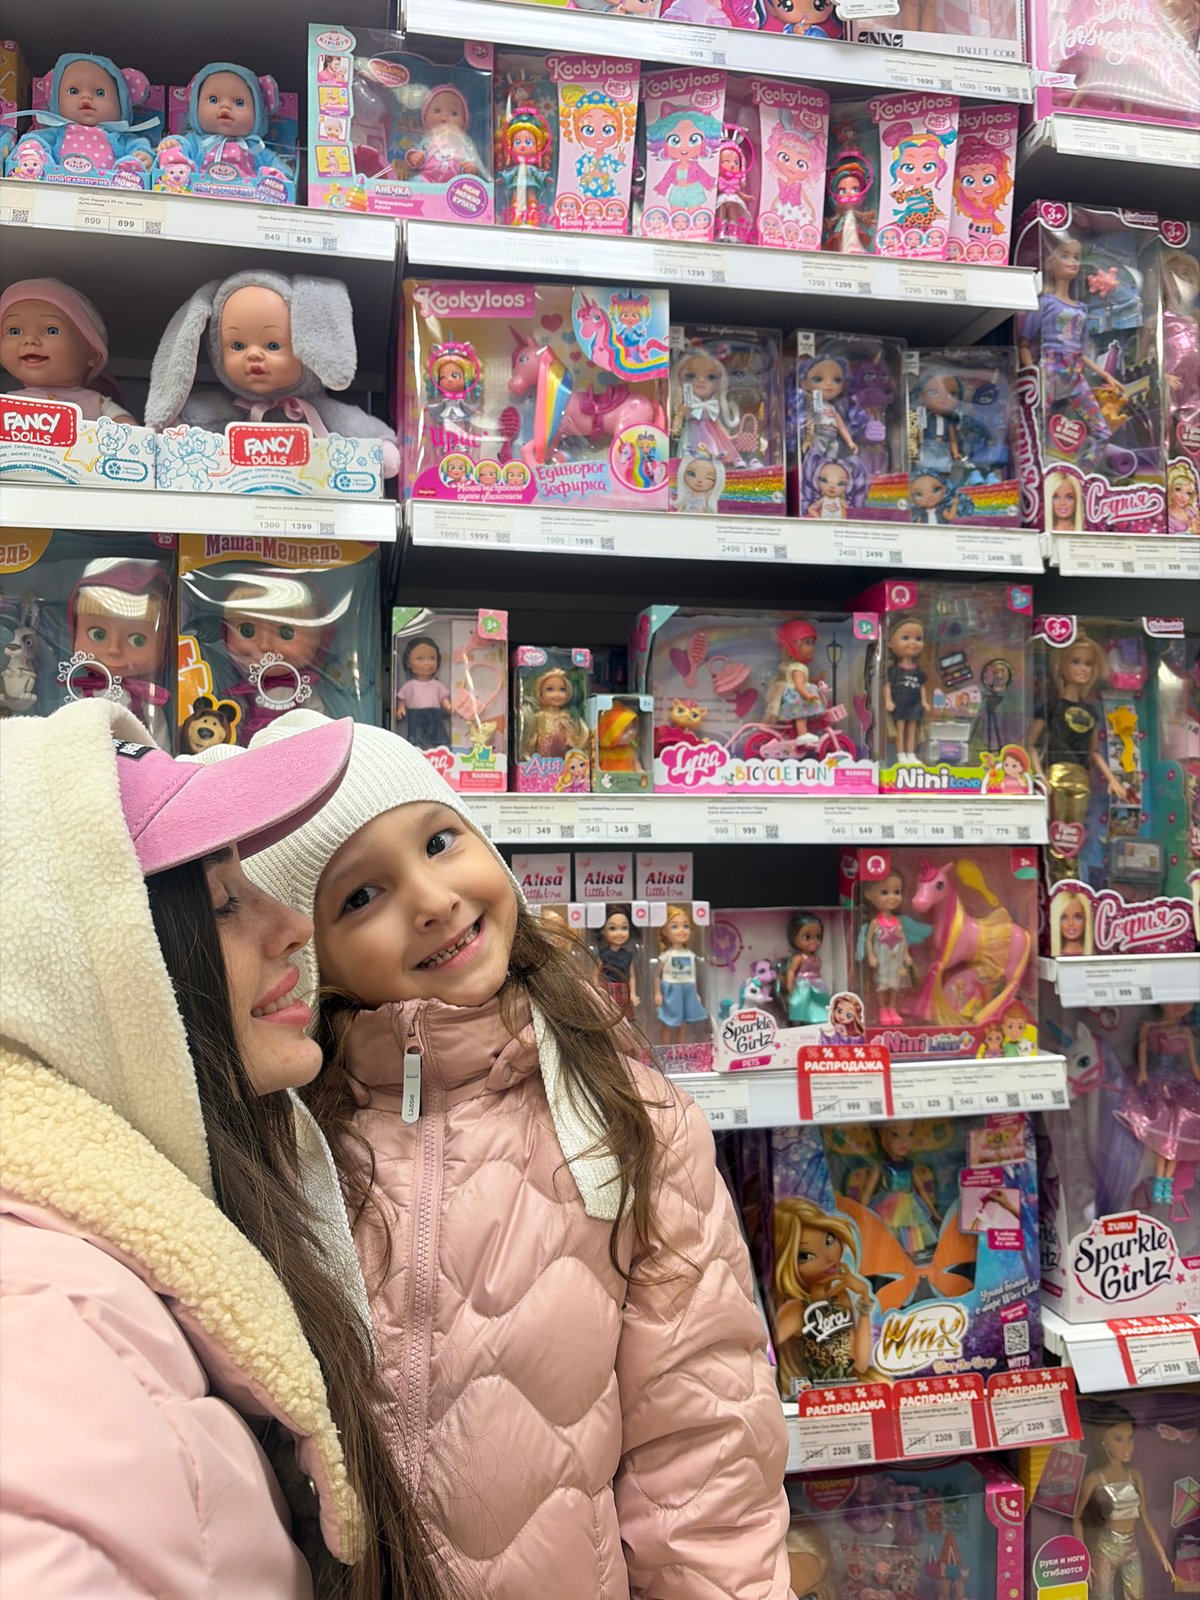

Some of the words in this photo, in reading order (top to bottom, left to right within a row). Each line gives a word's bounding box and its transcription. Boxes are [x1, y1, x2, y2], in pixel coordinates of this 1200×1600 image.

[690, 50, 704, 58] 999
[957, 46, 989, 56] BALLET
[993, 48, 1017, 59] CORE
[548, 58, 633, 80] Kookyloos
[642, 72, 720, 98] Kookyloos
[891, 75, 908, 83] 1699
[917, 77, 934, 86] 1699
[959, 82, 976, 90] 1699
[984, 85, 1001, 93] 1699
[752, 82, 823, 108] Kookyloos
[870, 97, 953, 122] Kookyloos
[958, 113, 1012, 135] okyloos
[48, 175, 65, 183] МОЙ
[66, 177, 110, 187] КАРАПУЗИК
[121, 171, 140, 184] МЕНЯ
[265, 179, 284, 191] МЕНЯ
[375, 184, 411, 197] АНЕЧКА
[462, 183, 481, 195] МЕНЯ
[259, 186, 286, 199] МОЖНО
[456, 189, 481, 205] МОЖНО
[452, 197, 478, 212] КУПАТЬ
[1047, 206, 1062, 220] 3+
[84, 217, 101, 225] 899
[118, 219, 135, 228] 899
[265, 233, 281, 241] 849
[1168, 225, 1181, 237] 3+
[296, 236, 312, 244] 849
[660, 267, 678, 275] 1299
[687, 269, 705, 277] 1299
[808, 279, 825, 287] 1299
[835, 281, 852, 289] 1299
[904, 286, 922, 294] 1299
[930, 288, 948, 296] 1299
[414, 288, 526, 314] Kookyloos
[4, 412, 60, 433] FANCY
[11, 431, 52, 445] DOLLS
[244, 435, 295, 457] FANCY
[251, 455, 287, 466] DOLLS
[536, 462, 606, 482] Единорог
[540, 478, 607, 499] Зефирка
[259, 521, 280, 529] 1399
[440, 531, 459, 539] 1999
[470, 532, 489, 540] 1999
[546, 536, 565, 544] 1999
[575, 538, 594, 546] 1999
[722, 544, 740, 552] 2499
[206, 535, 252, 557] Маша
[262, 537, 342, 562] Медведь
[486, 621, 497, 630] 3+
[1051, 622, 1067, 635] 3+
[526, 758, 560, 775] Аня
[671, 750, 721, 783] Lyna
[735, 765, 791, 782] BICYCLE
[796, 766, 827, 782] FUN
[896, 767, 949, 789] Nini
[507, 827, 522, 835] 349
[614, 825, 629, 833] 349
[714, 826, 729, 834] 999
[742, 826, 756, 834] 999
[832, 826, 846, 834] 649
[859, 826, 873, 834] 649
[996, 827, 1010, 835] 779
[522, 872, 563, 886] Alisa
[584, 871, 624, 885] Alisa
[645, 871, 685, 885] Alisa
[723, 1017, 773, 1044] Sparkle
[736, 1031, 774, 1053] Girlz
[884, 1032, 926, 1053] Nini
[742, 1058, 760, 1067] PETS
[804, 1061, 884, 1071] РАСПРОДАЖА
[710, 1112, 725, 1120] 349
[1107, 1221, 1133, 1232] ZURU
[1074, 1225, 1168, 1277] Sparkle
[1100, 1256, 1172, 1300] Girlz
[1176, 1301, 1187, 1311] 3+
[802, 1301, 853, 1342] Flora
[1119, 1322, 1195, 1336] РАСПРОДАЖА
[880, 1311, 967, 1361] Winx
[994, 1382, 1069, 1398] РАСПРОДАЖА
[900, 1390, 978, 1408] РАСПРОДАЖА
[806, 1399, 886, 1416] РАСПРОДАЖА
[1027, 1422, 1044, 1431] 2309
[935, 1433, 952, 1442] 2309
[833, 1447, 851, 1456] 2309
[1039, 1558, 1058, 1569] руки
[1066, 1554, 1086, 1564] ноги
[1042, 1565, 1083, 1577] сгибаются
